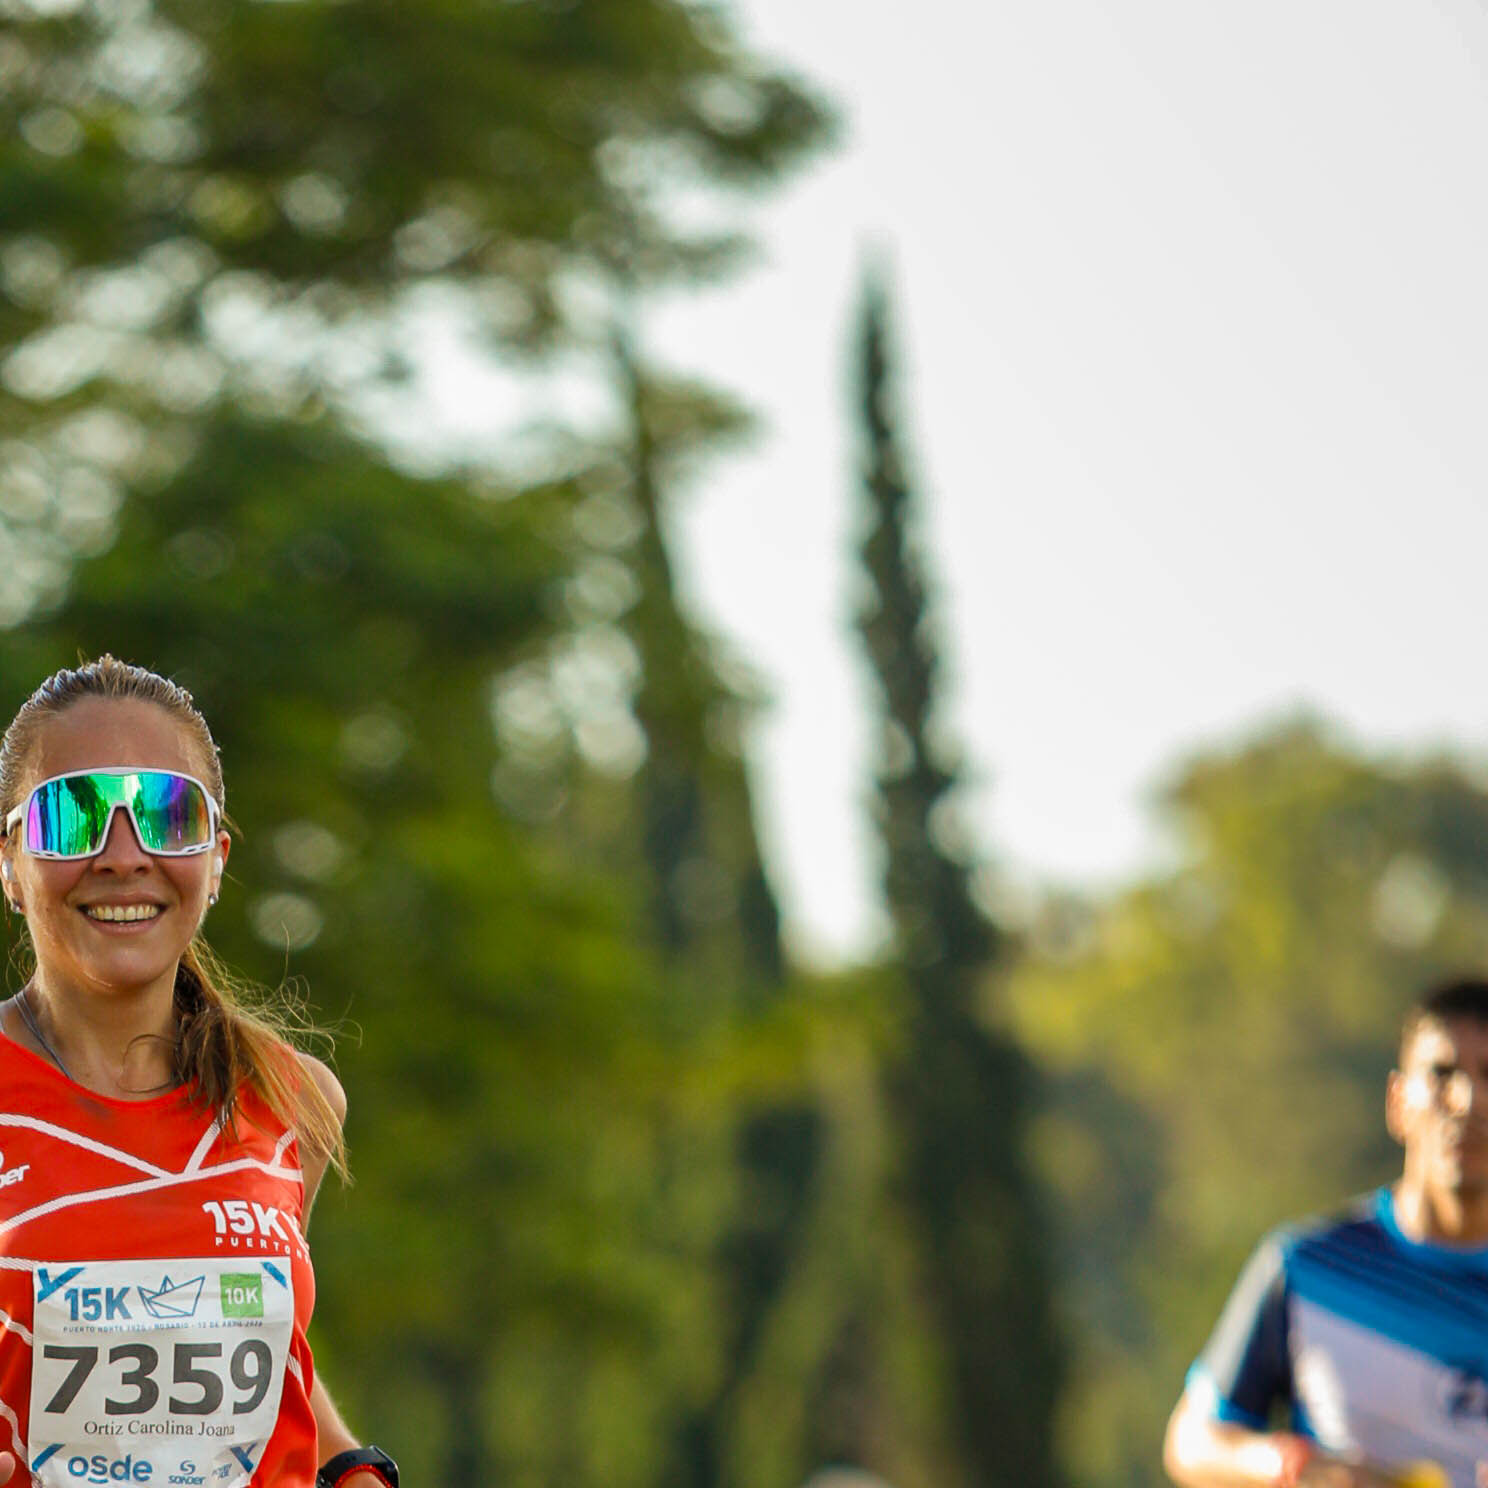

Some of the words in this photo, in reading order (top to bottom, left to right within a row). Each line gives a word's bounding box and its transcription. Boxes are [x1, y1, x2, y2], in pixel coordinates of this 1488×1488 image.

[202, 1200, 289, 1241] 15K
[215, 1236, 290, 1255] PUERTO
[64, 1286, 132, 1321] 15K
[225, 1286, 258, 1305] 10K
[43, 1339, 273, 1415] 7359
[84, 1421, 124, 1435] Ortiz
[127, 1420, 193, 1435] Carolina
[198, 1421, 235, 1437] Joana
[67, 1454, 153, 1483] osde
